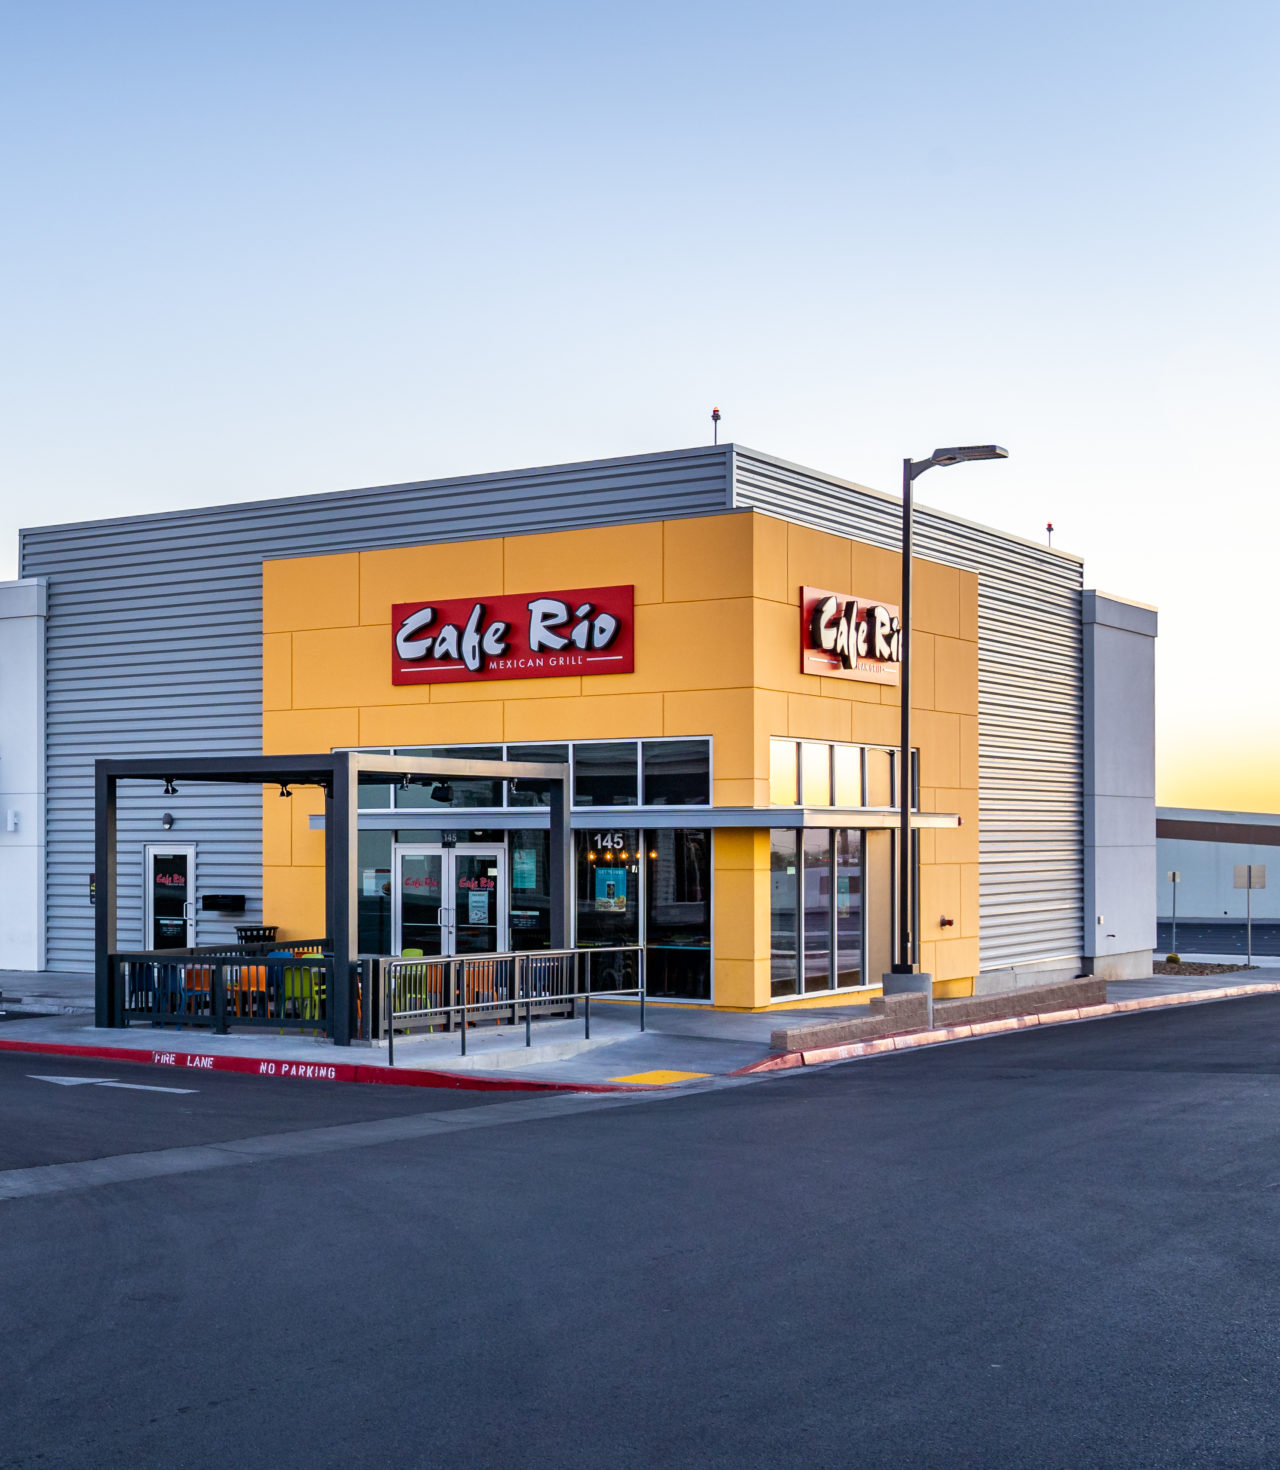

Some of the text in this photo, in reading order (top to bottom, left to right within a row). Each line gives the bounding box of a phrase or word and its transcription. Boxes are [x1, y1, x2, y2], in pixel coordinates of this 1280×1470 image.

[395, 603, 507, 672] Cafe
[812, 596, 868, 669] Cafe
[489, 656, 581, 669] MEXICAN GRILL
[444, 834, 457, 842] 145
[594, 833, 624, 849] 145
[154, 1052, 214, 1069] FIRE LANE
[260, 1062, 336, 1079] NO PARKING
